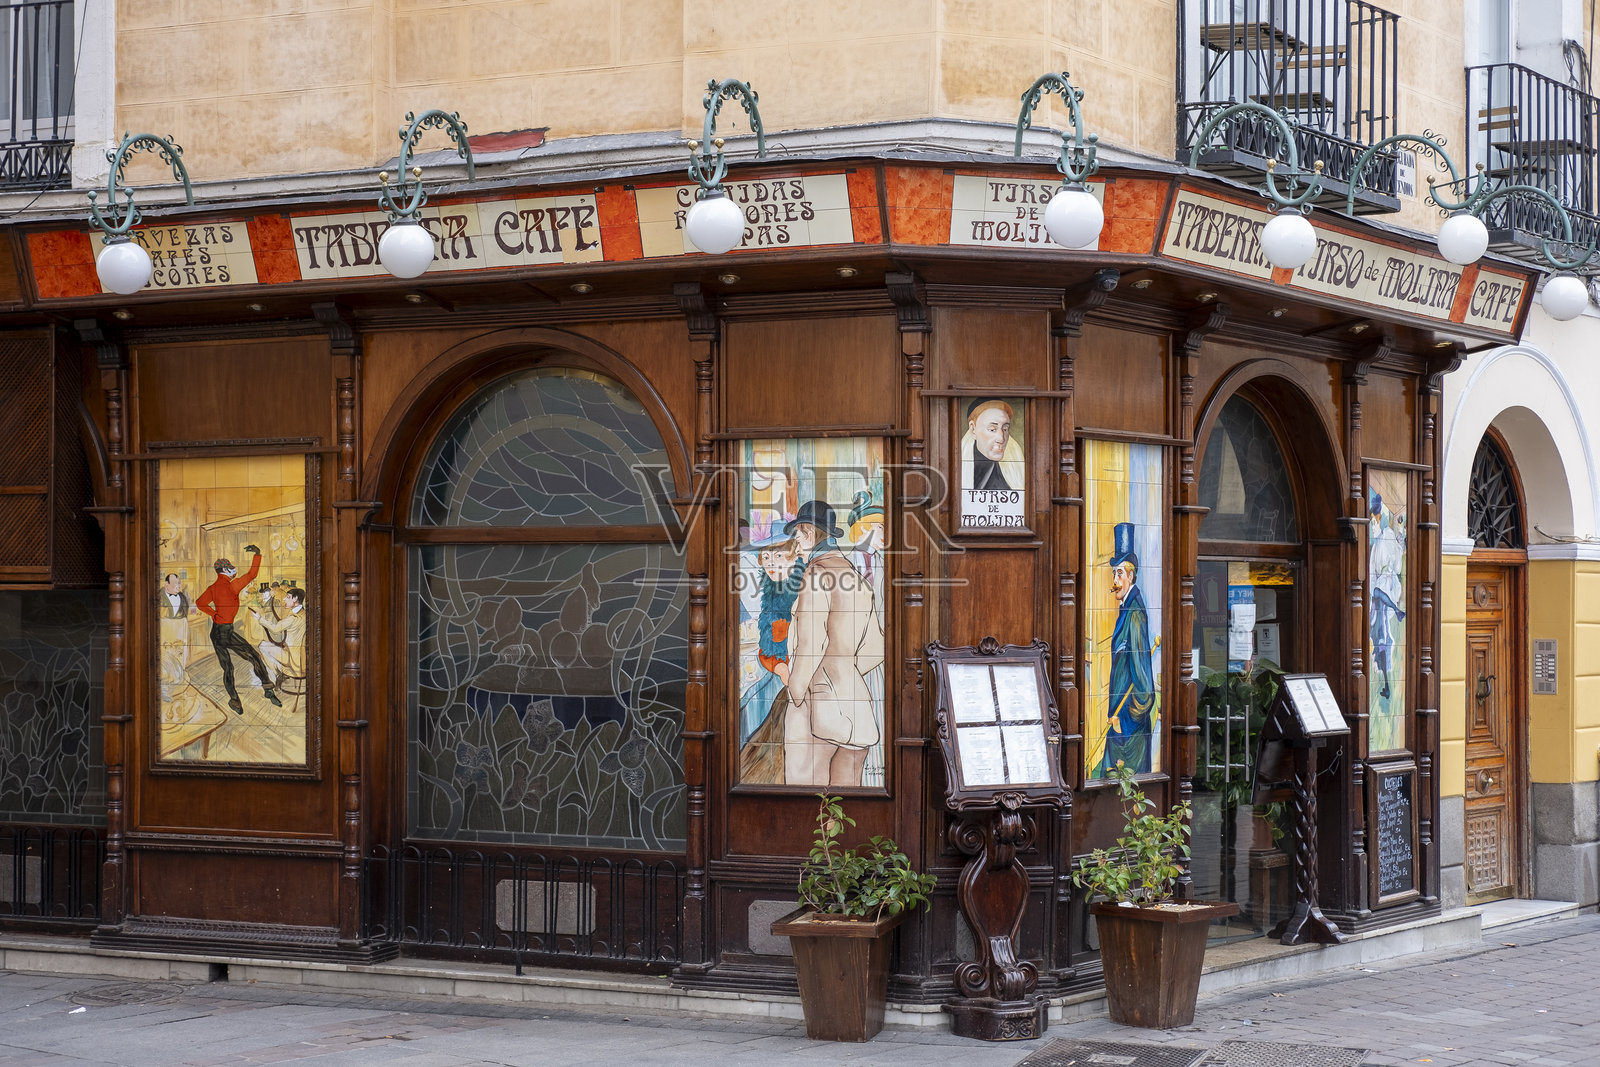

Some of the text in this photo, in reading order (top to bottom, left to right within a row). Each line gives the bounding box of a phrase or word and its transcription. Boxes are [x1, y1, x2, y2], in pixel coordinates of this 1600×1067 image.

[676, 180, 805, 208] CIDAS
[988, 182, 1063, 204] TIRS
[674, 201, 815, 230] RONES
[1016, 206, 1039, 221] DE
[136, 226, 233, 248] RVEZAS
[741, 225, 790, 246] PAS
[1172, 200, 1271, 269] TABERN
[146, 265, 230, 288] CORES
[1298, 237, 1462, 310] IRSO de MOLINA
[968, 490, 1020, 504] TIRSO
[988, 504, 1000, 513] DE
[962, 515, 1025, 527] MOLINA
